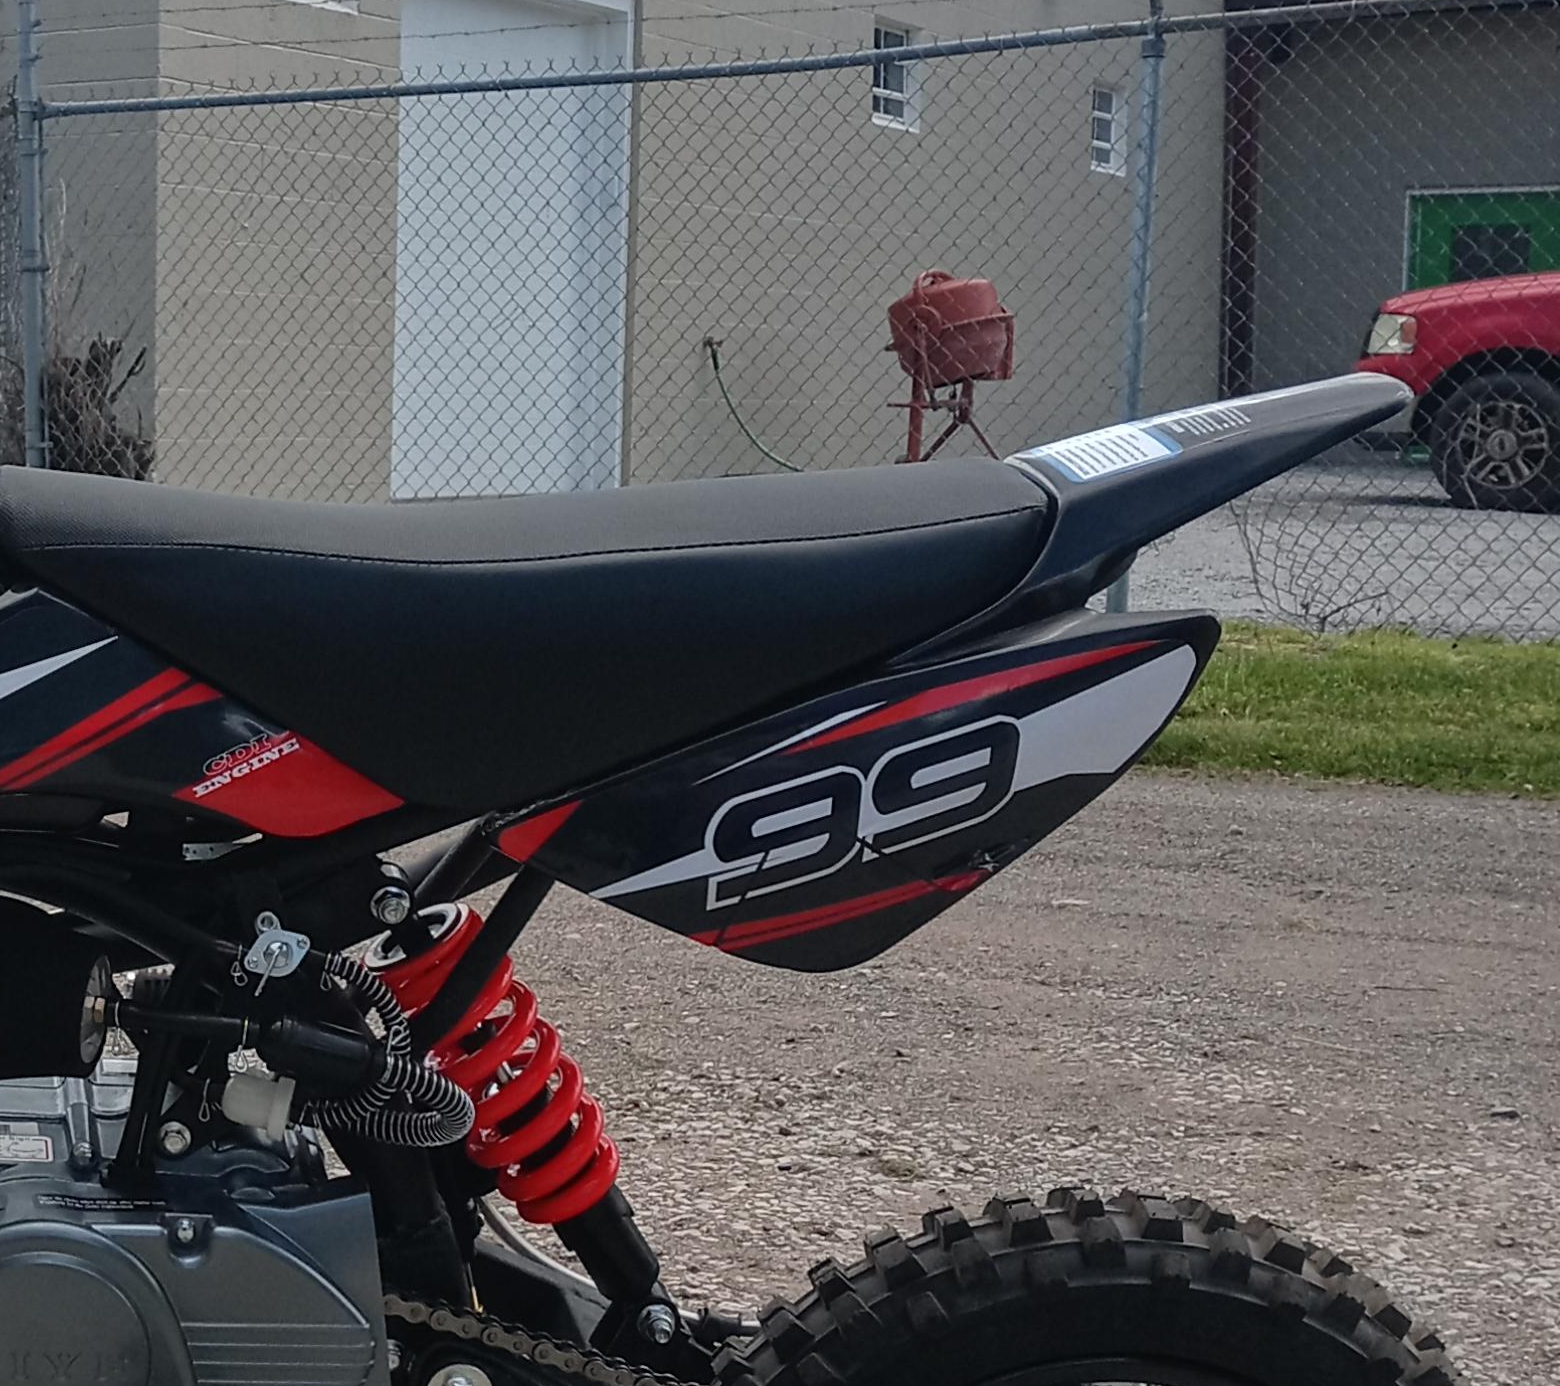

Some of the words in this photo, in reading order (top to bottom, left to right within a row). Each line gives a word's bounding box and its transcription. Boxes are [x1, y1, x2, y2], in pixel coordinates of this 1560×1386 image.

[192, 738, 300, 798] ENGINE
[203, 733, 272, 776] CDI
[704, 714, 1022, 911] 99
